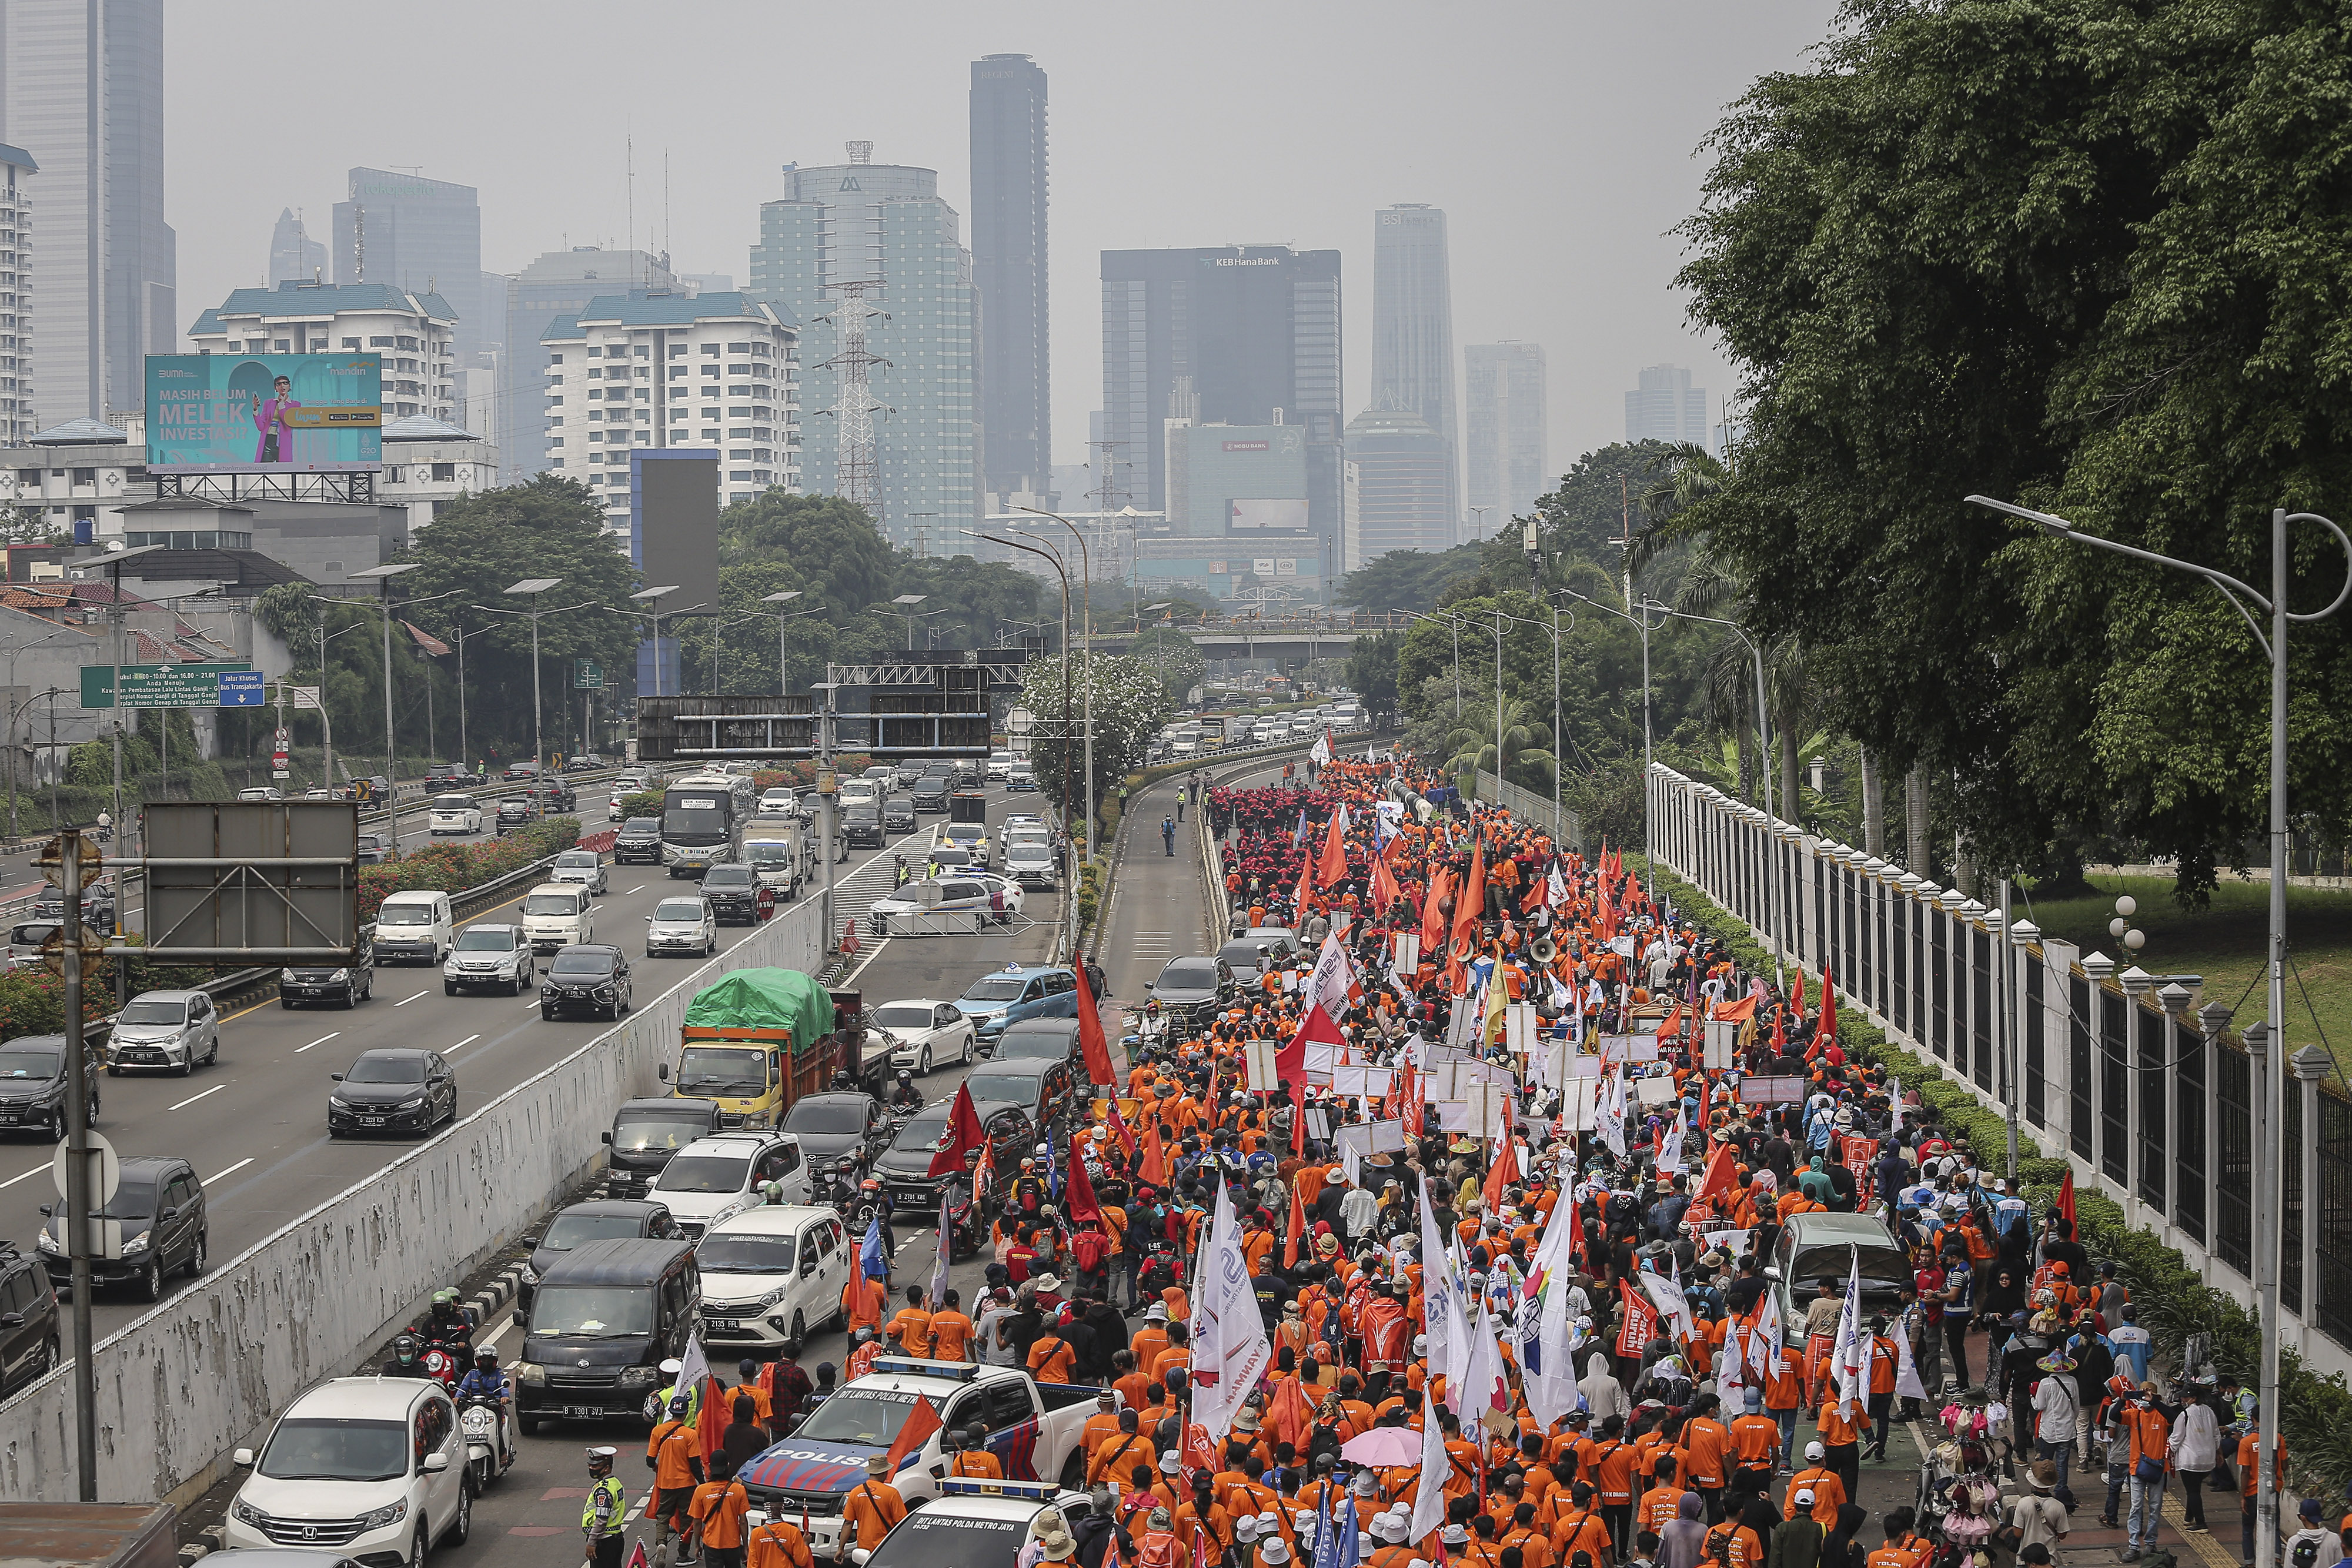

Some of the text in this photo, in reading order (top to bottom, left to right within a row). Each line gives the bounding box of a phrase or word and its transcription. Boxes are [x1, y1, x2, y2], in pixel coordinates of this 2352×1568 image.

[1383, 214, 1401, 225] BSI
[330, 367, 366, 375] mandiri
[160, 389, 246, 400] MASIH BELUM
[159, 403, 246, 425] MELEK
[160, 427, 248, 440] INVESTASI?
[1608, 1115, 1621, 1131] KSPI
[1626, 1309, 1641, 1348] Buruh
[838, 1390, 851, 1399] DIT
[850, 1390, 876, 1400] LANTAS
[875, 1392, 898, 1402] POLDA
[897, 1394, 918, 1405] METR
[928, 1517, 953, 1527] LANTAS
[951, 1520, 974, 1528] POLDA
[973, 1521, 998, 1530] METRO
[997, 1523, 1015, 1532] JAYA
